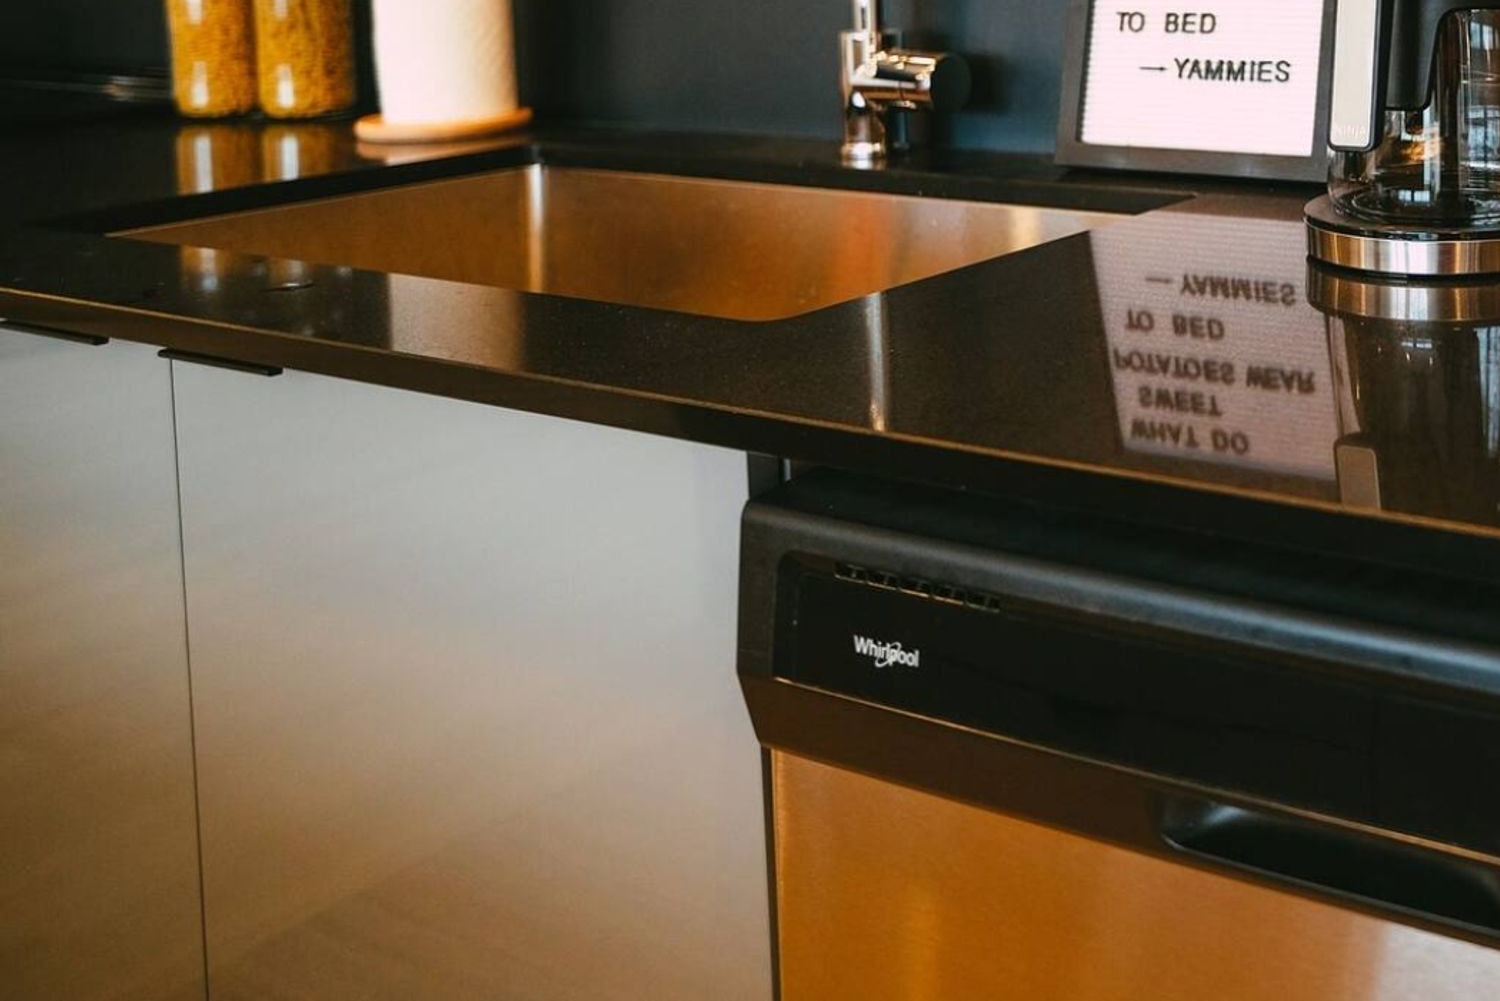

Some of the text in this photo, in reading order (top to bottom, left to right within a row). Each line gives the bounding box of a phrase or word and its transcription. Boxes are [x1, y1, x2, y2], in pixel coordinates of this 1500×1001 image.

[1116, 12, 1217, 35] TO BED
[1174, 57, 1292, 83] YAMMIES
[853, 634, 920, 668] Whirlpool
